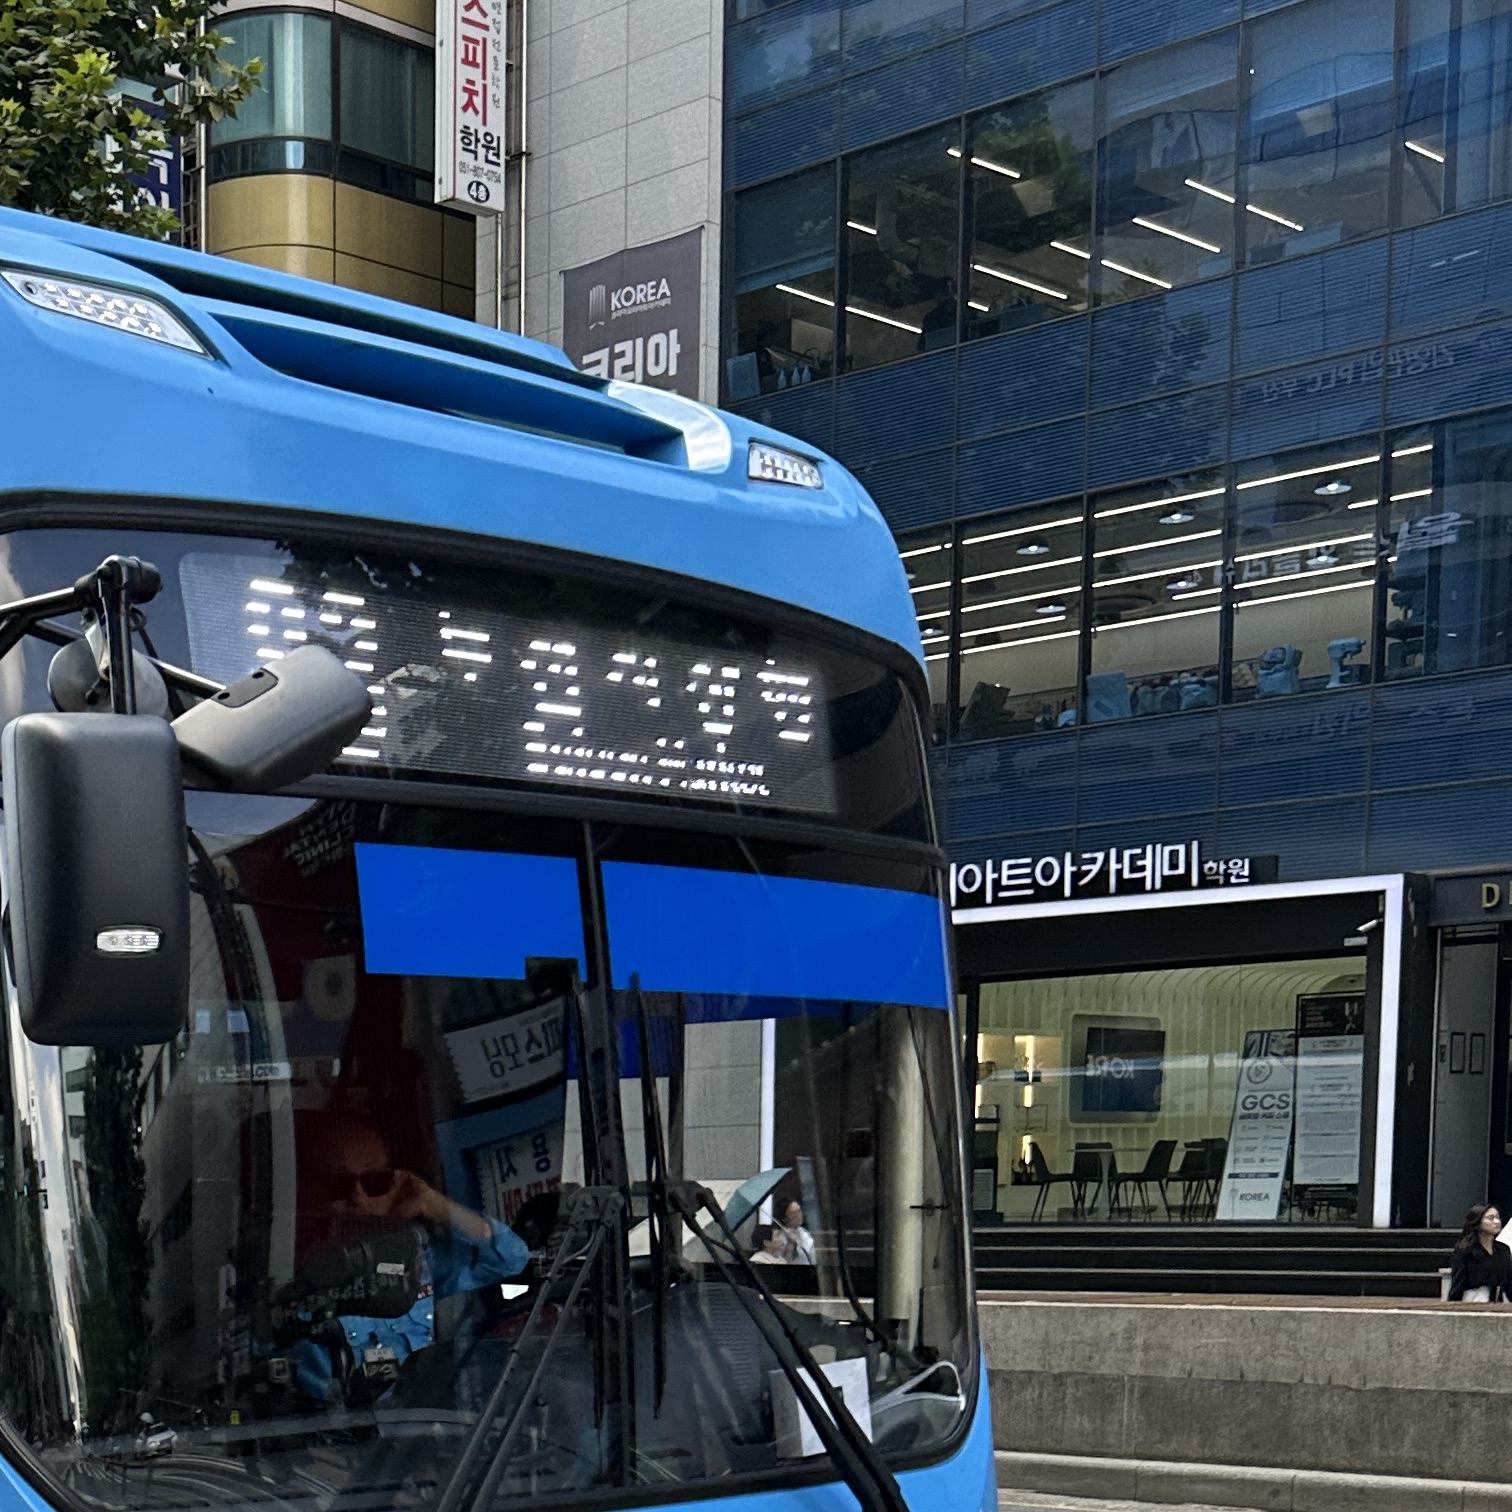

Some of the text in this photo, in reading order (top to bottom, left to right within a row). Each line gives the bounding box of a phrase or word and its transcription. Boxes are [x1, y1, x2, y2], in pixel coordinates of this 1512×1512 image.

[459, 125, 502, 168] 학원
[610, 278, 672, 312] KOREA
[949, 840, 1250, 907] 아트아카데미 학원
[1481, 880, 1512, 909] D
[1241, 1092, 1291, 1111] GCS
